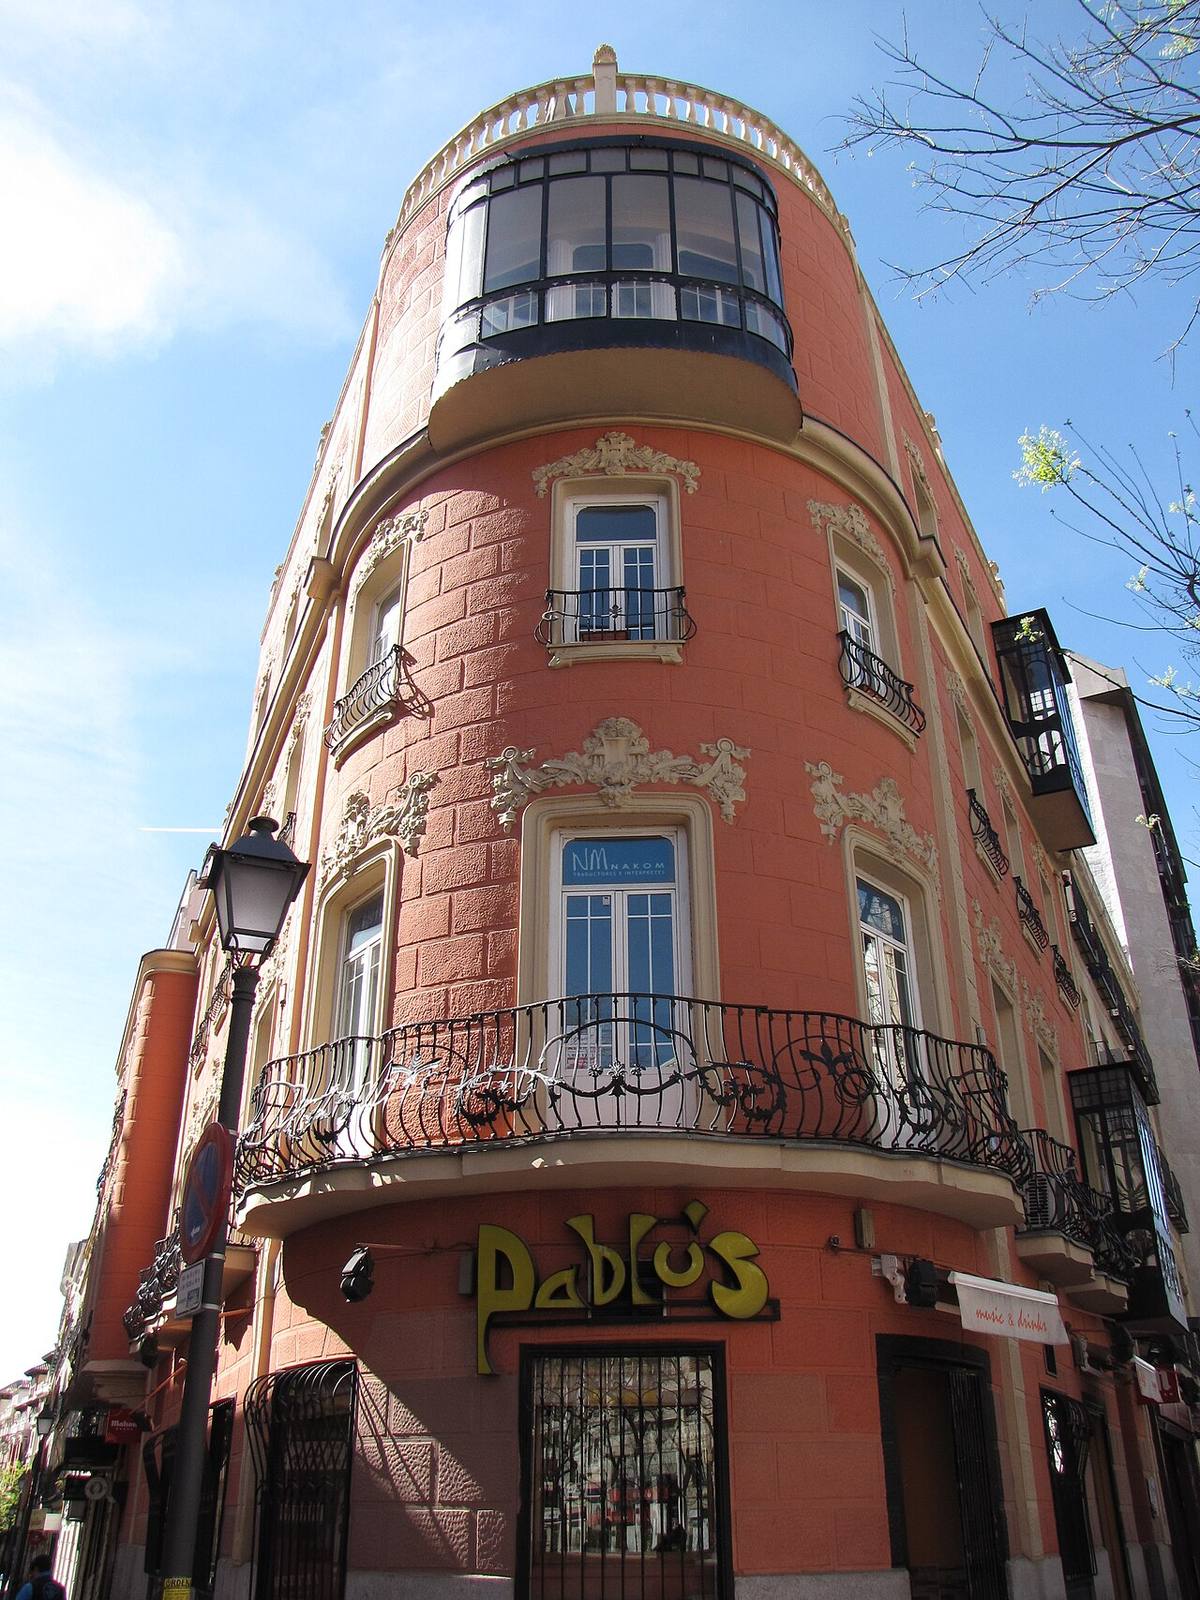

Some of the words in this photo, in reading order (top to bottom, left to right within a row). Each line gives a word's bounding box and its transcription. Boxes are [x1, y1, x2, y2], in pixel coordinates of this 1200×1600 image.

[572, 847, 608, 871] NM
[610, 862, 665, 871] NAKOM
[976, 1306, 1004, 1324] music
[1018, 1307, 1048, 1332] drinks
